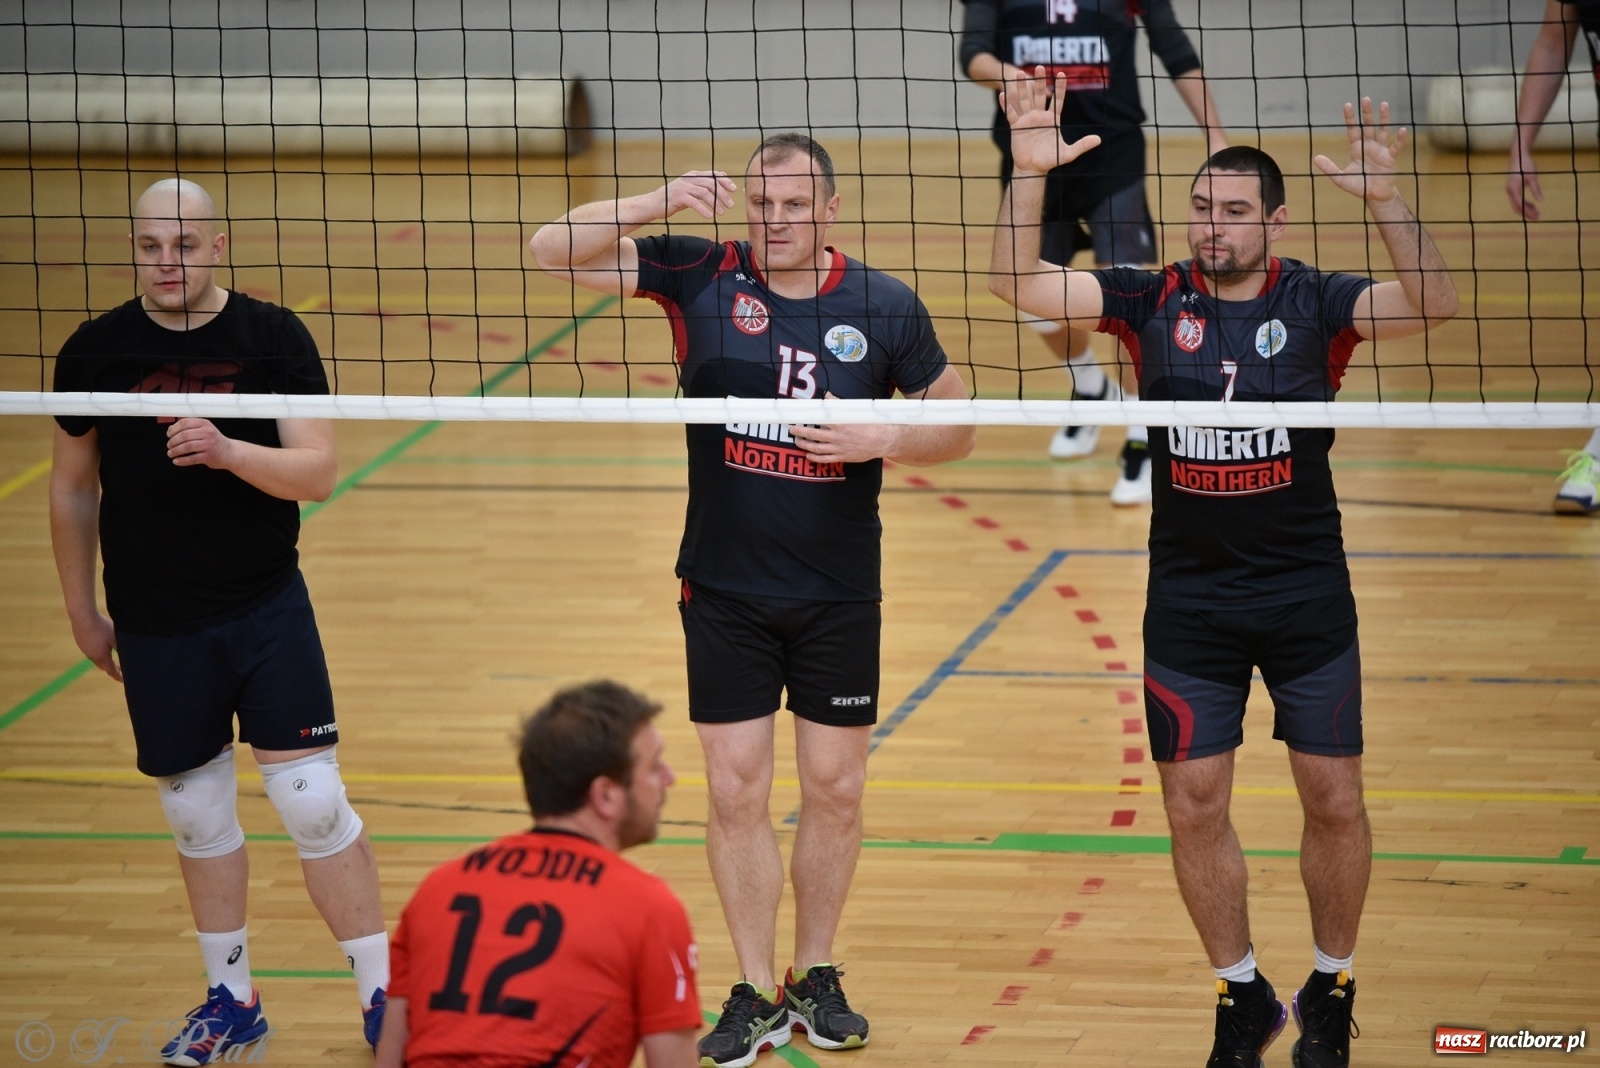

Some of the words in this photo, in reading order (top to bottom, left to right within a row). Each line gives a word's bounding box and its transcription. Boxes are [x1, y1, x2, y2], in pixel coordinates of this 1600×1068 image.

[777, 344, 817, 400] 13
[1220, 360, 1238, 402] 7
[1168, 426, 1291, 461] OMERTA
[1170, 458, 1292, 492] NORTHERN
[462, 845, 605, 886] WOJDA
[428, 892, 564, 1021] 12
